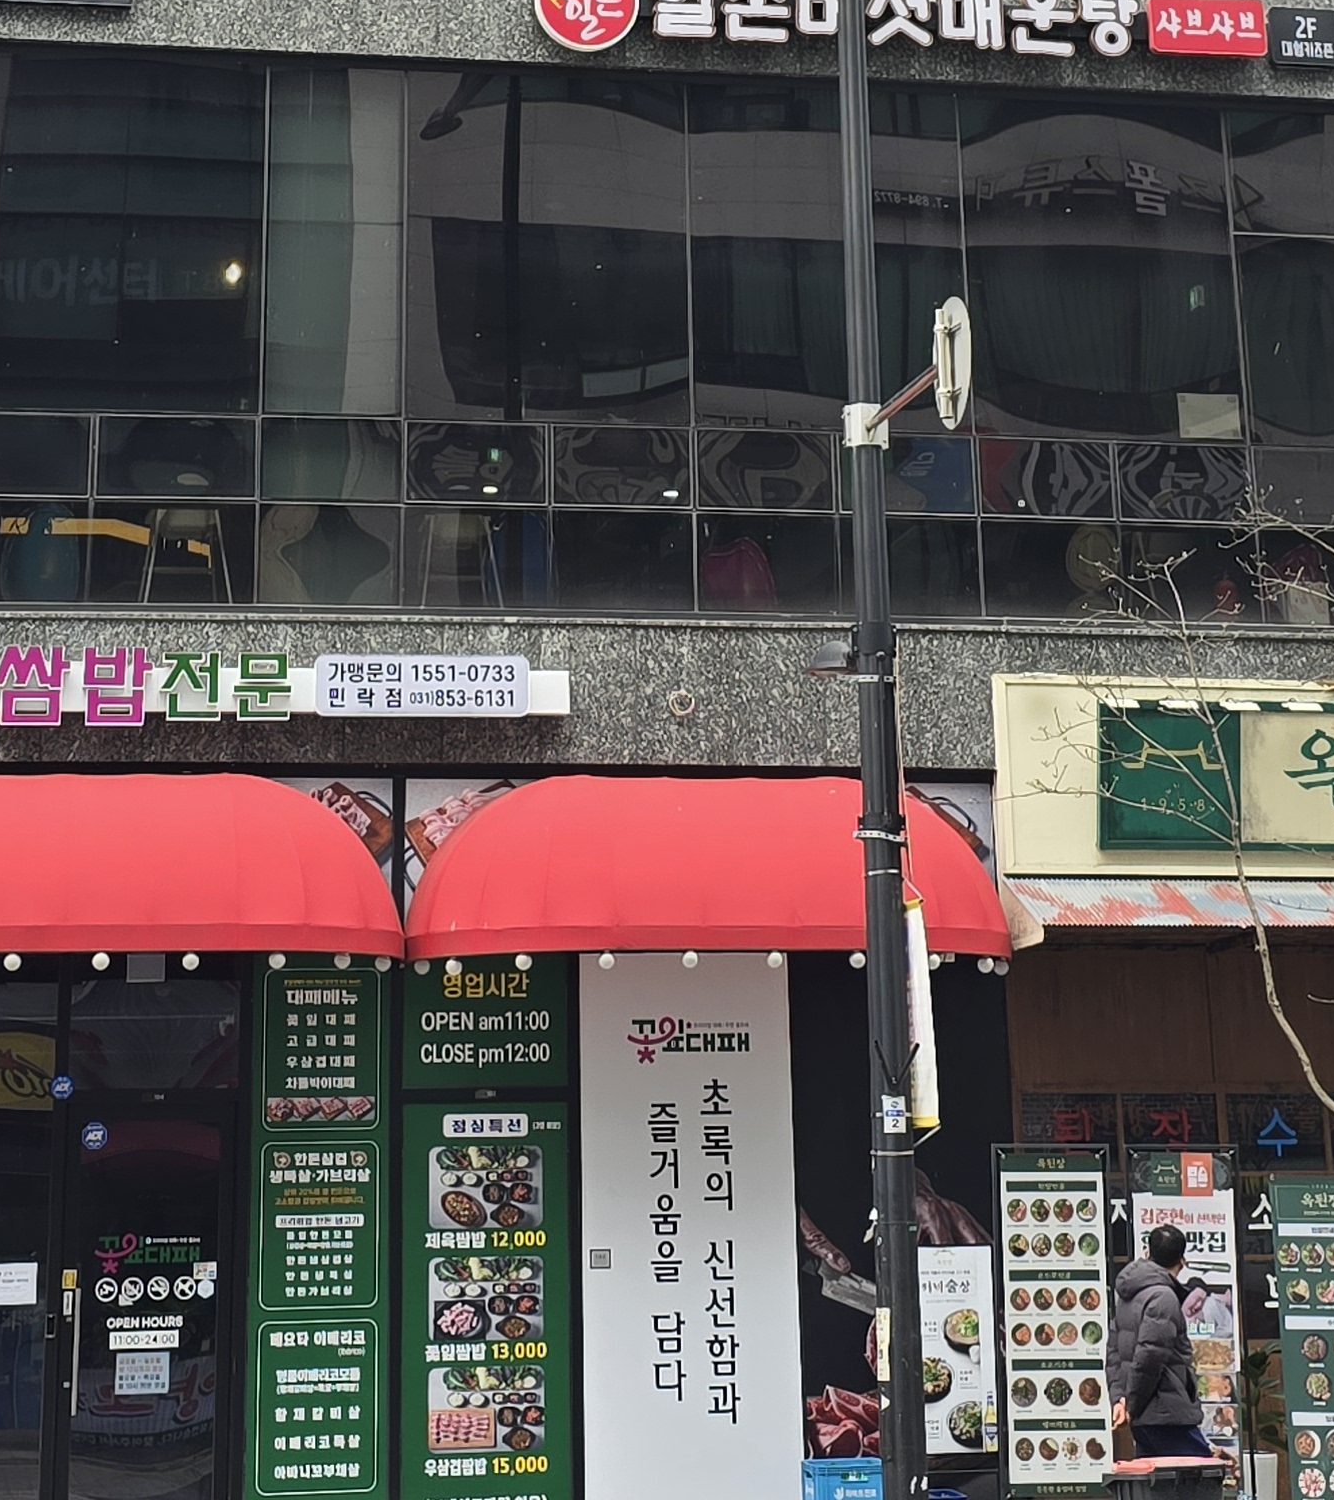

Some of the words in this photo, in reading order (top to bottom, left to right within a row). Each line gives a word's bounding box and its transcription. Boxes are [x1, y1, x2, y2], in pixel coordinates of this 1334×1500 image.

[1155, 8, 1263, 42] 샤브샤브
[1295, 16, 1318, 37] 2F
[327, 661, 403, 685] 가맹문의
[410, 661, 517, 685] 1551-0733
[285, 988, 359, 1006] 대패메뉴
[442, 971, 530, 999] 영업시간
[421, 1011, 475, 1032] OPEN
[478, 1010, 551, 1031] am11:00
[626, 1017, 751, 1065] 꽃잎대패
[420, 1044, 475, 1064] CLOSE
[477, 1043, 551, 1068] pm12:00
[699, 1078, 735, 1212] 초록의
[647, 1102, 683, 1284] 즐거움을
[490, 1229, 547, 1250] 12,000
[106, 1316, 141, 1330] OPEN
[142, 1314, 184, 1329] HOURS
[703, 1239, 742, 1425] 신선함과
[490, 1342, 548, 1363] 13,000
[651, 1312, 687, 1403] 담다
[491, 1456, 549, 1476] 15,000
